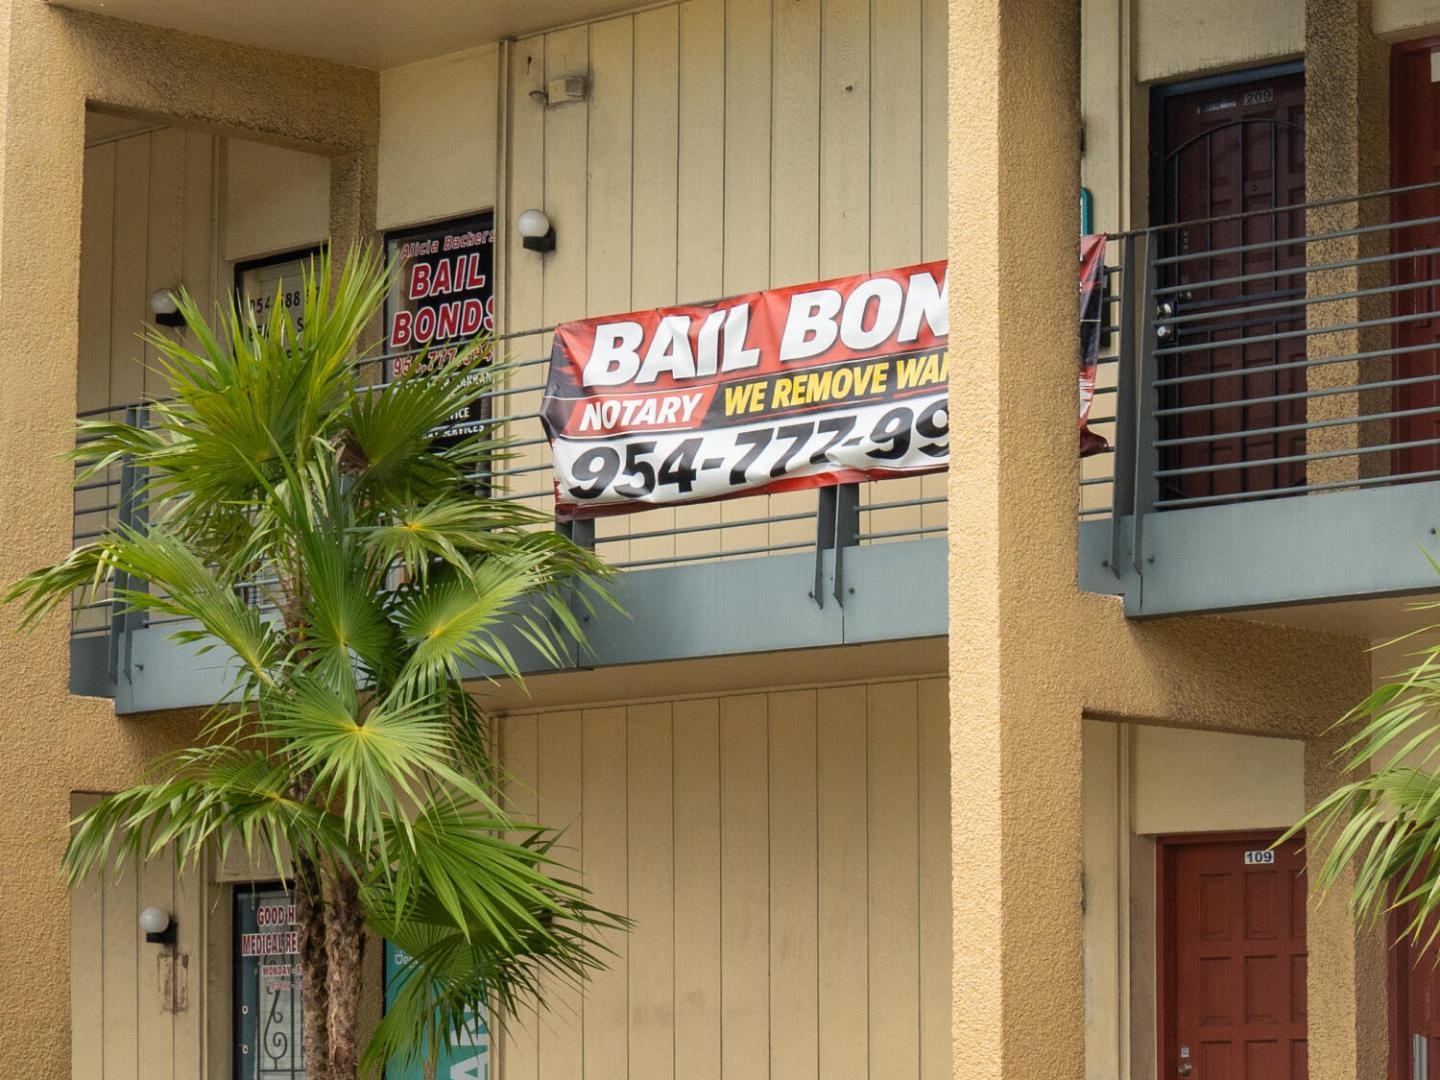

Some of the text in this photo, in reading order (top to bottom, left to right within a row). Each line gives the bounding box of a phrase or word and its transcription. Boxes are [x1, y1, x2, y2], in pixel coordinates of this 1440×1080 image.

[409, 252, 486, 300] BAIL
[582, 303, 761, 387] BAIL
[724, 381, 769, 417] WE
[771, 361, 889, 410] REMOVE
[579, 391, 704, 432] NOTARY
[1247, 851, 1272, 863] 109
[257, 906, 285, 926] GOOD
[241, 933, 283, 956] MEDICAL
[262, 965, 291, 977] MONDAY
